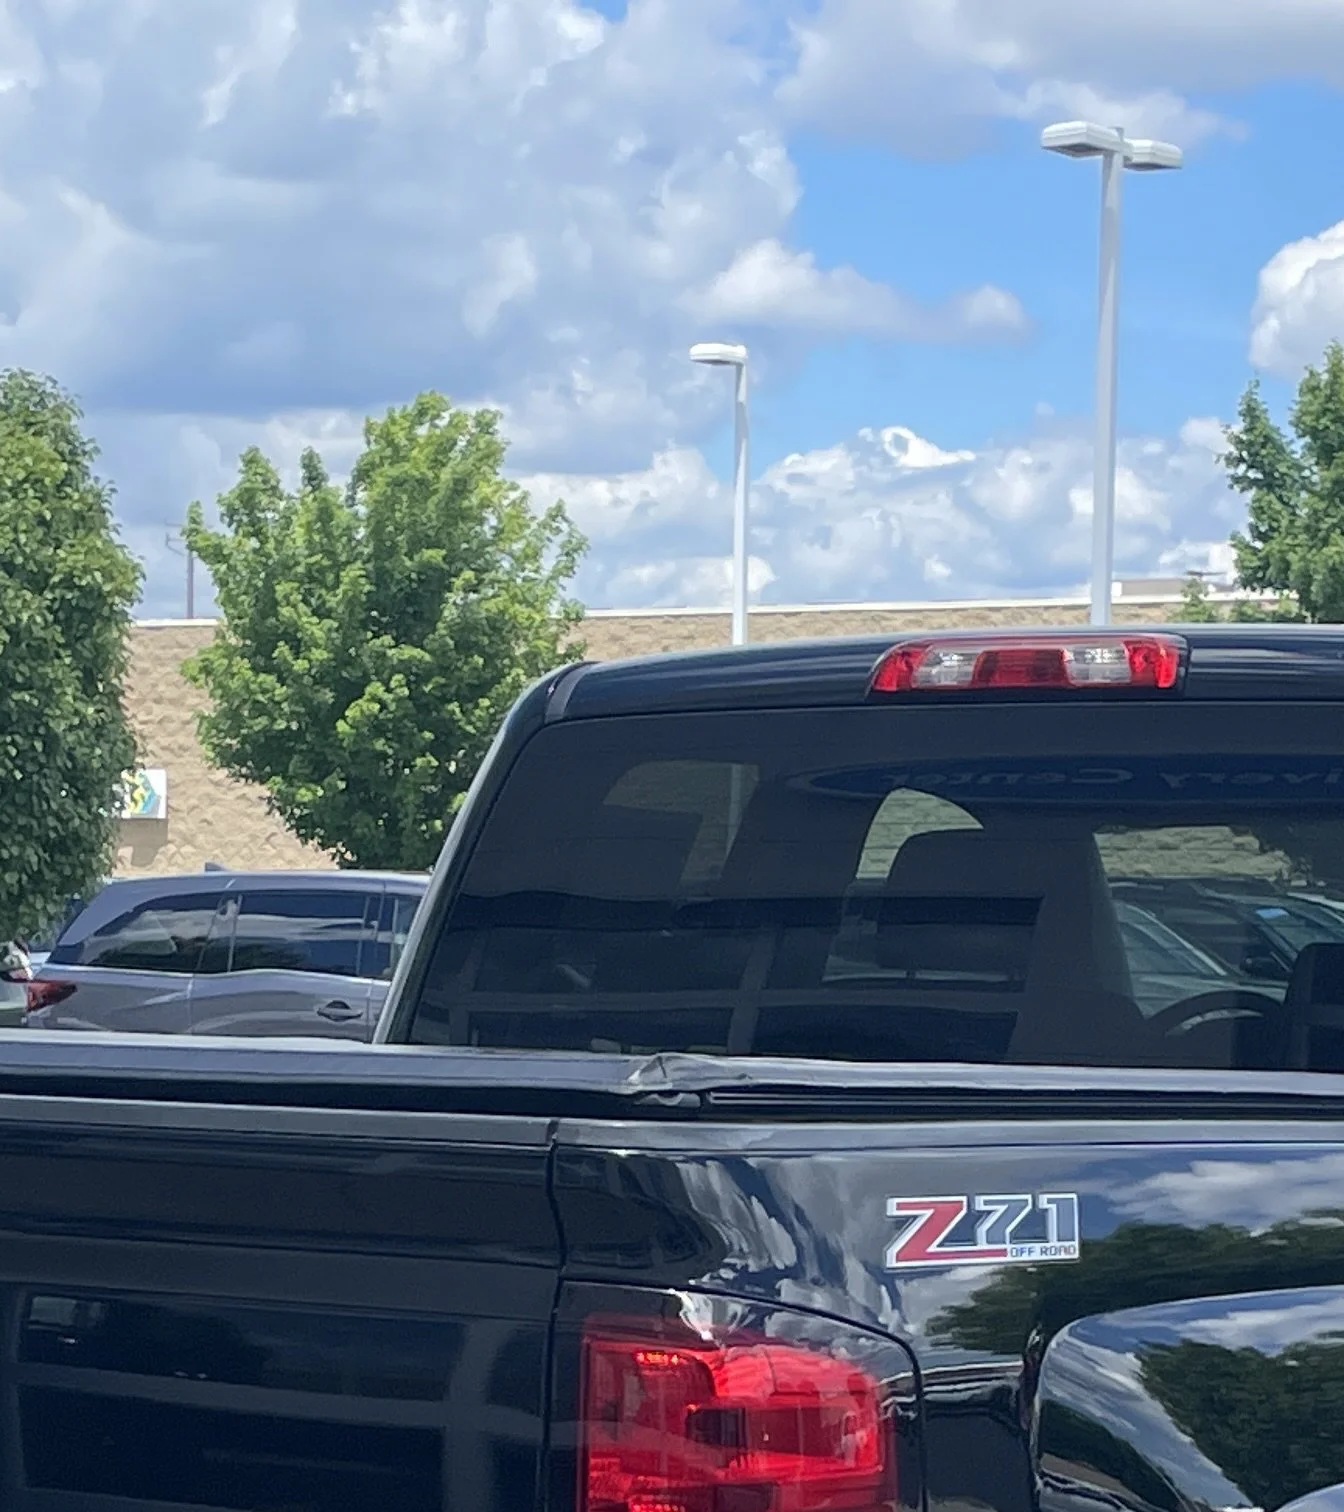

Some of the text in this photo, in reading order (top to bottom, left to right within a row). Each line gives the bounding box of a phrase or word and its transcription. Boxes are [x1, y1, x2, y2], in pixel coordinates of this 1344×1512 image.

[885, 1192, 1080, 1269] Z71
[1010, 1244, 1077, 1258] OFF ROAD
